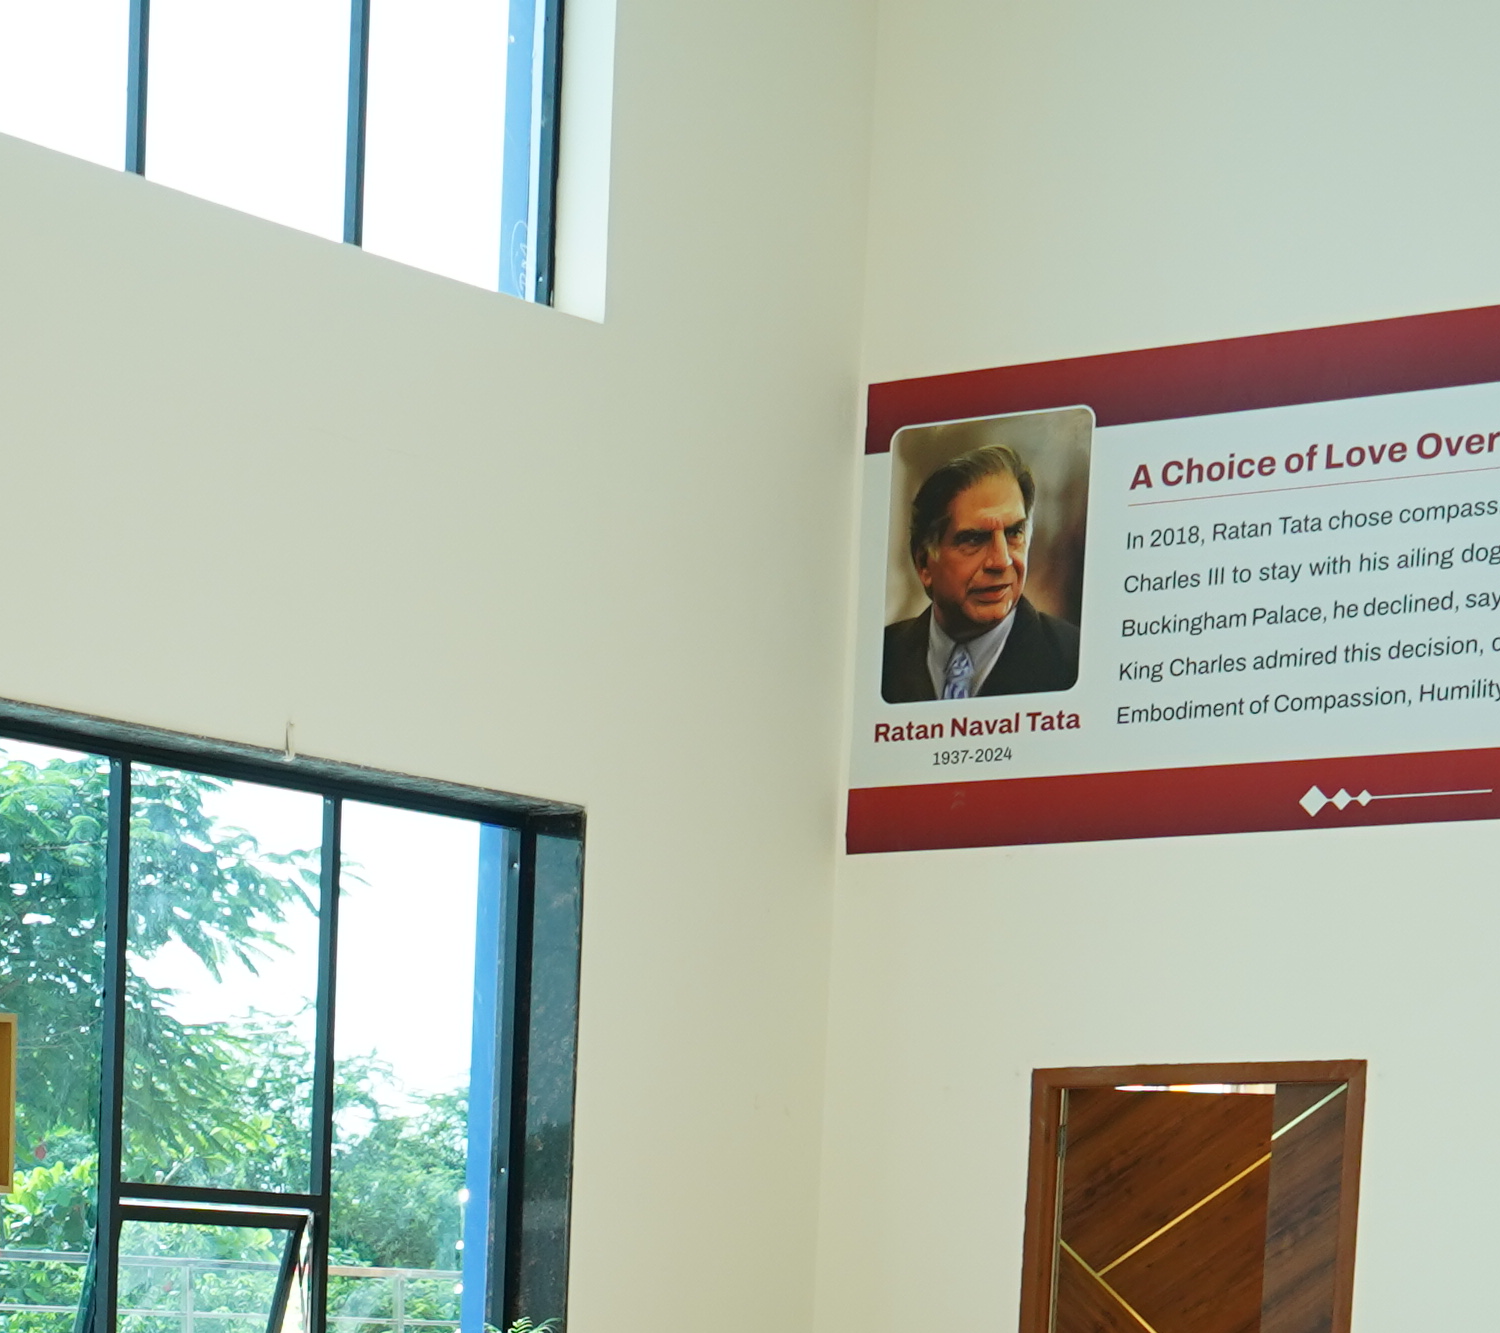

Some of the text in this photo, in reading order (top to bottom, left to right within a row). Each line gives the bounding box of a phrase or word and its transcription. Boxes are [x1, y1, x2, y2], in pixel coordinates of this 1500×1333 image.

[1128, 462, 1154, 491] A
[1160, 451, 1277, 488] Choice
[1283, 442, 1319, 475] of
[1323, 440, 1408, 471] Love
[1125, 530, 1145, 551] In
[1148, 523, 1205, 548] 2018,
[1211, 519, 1273, 542] Ratan
[1277, 513, 1323, 535] Tata
[1327, 508, 1394, 531] chose
[1122, 569, 1201, 594] Charles
[1207, 565, 1225, 587] III
[1231, 564, 1253, 584] to
[1257, 561, 1303, 584] stay
[1307, 553, 1352, 577] with
[1358, 550, 1390, 573] his
[1395, 546, 1455, 571] ailing
[1120, 610, 1248, 638] Buckingham
[1251, 603, 1328, 627] Palace,
[1332, 599, 1359, 620] he
[1362, 589, 1460, 618] declined,
[1118, 660, 1164, 684] King
[1168, 652, 1247, 678] Charles
[1251, 643, 1338, 671] admired
[1342, 641, 1382, 664] this
[1386, 634, 1484, 661] decision,
[873, 710, 1081, 743] Ratan Naval Tata
[1115, 696, 1245, 725] Embodiment
[1248, 693, 1270, 715] of
[1272, 685, 1412, 714] Compassion,
[932, 746, 1013, 766] 1937-2024
